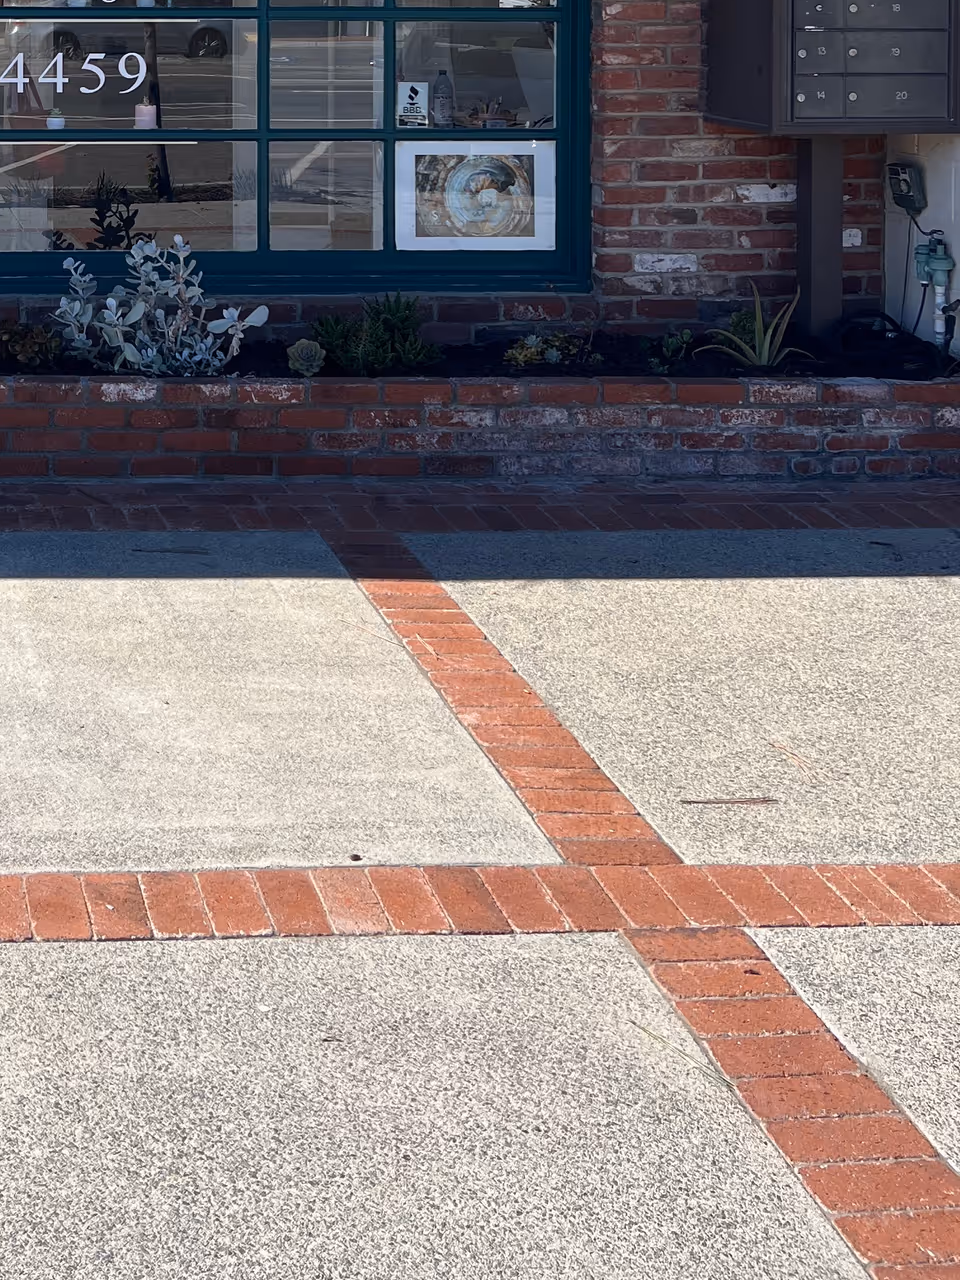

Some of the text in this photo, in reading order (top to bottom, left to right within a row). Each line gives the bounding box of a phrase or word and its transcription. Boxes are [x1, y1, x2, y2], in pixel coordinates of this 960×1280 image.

[892, 3, 901, 13] 18
[817, 47, 827, 56] 13
[817, 90, 826, 100] 14
[895, 91, 908, 100] 20
